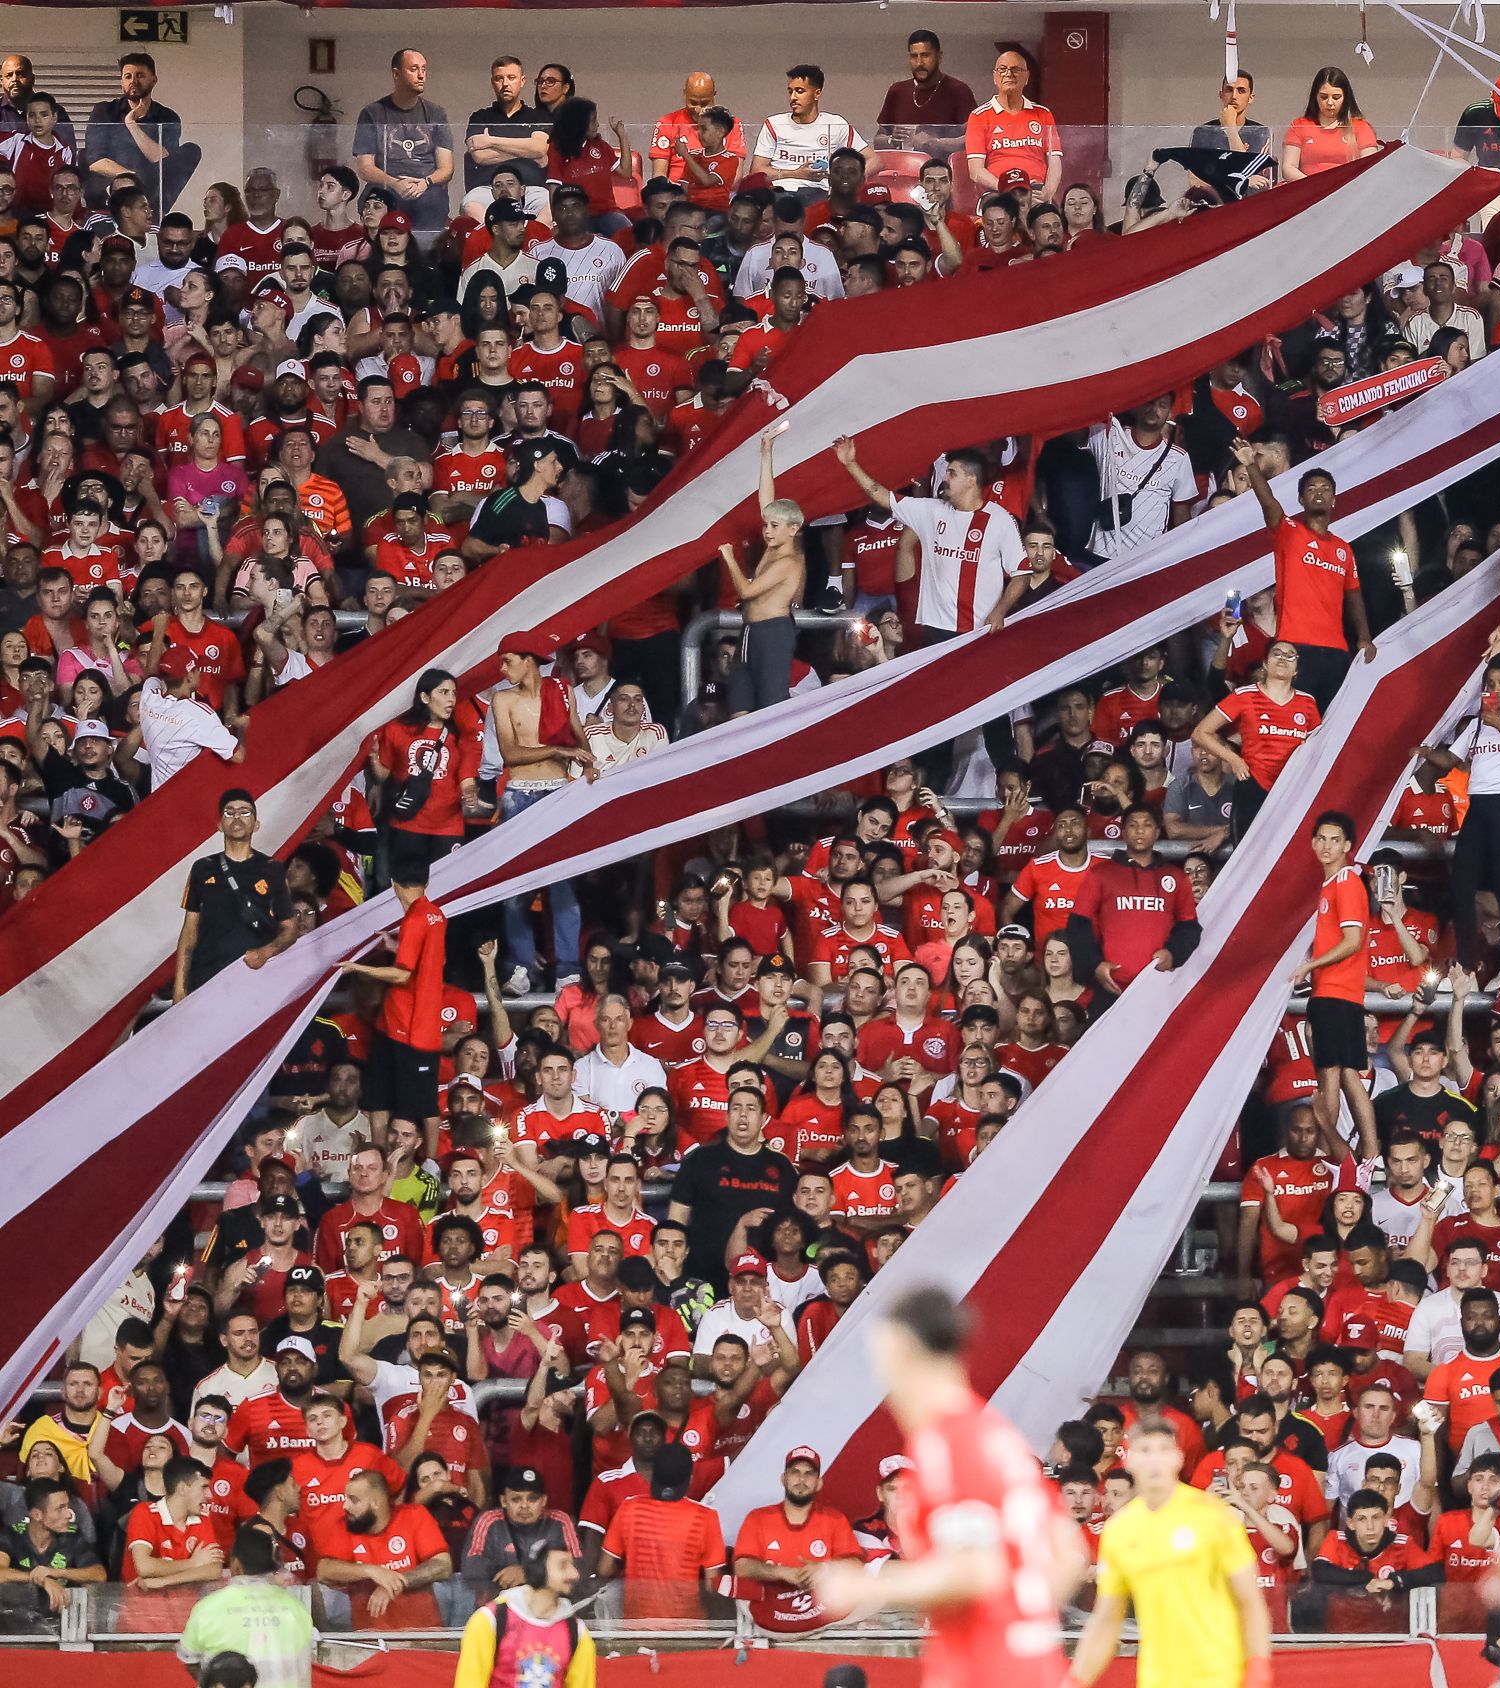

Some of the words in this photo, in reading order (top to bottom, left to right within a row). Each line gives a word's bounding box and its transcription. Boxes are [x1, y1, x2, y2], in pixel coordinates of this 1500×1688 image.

[1003, 138, 1043, 149] Banrisul
[248, 260, 281, 272] Banris
[567, 273, 606, 284] anrisul
[657, 322, 701, 333] Banrisul
[0, 370, 26, 382] nrisul
[1338, 386, 1380, 411] COMANDO
[1383, 370, 1428, 397] FEMININO
[857, 538, 897, 553] Banris
[149, 710, 184, 725] banrisul
[1117, 897, 1165, 911] INTER
[292, 1268, 312, 1280] GV
